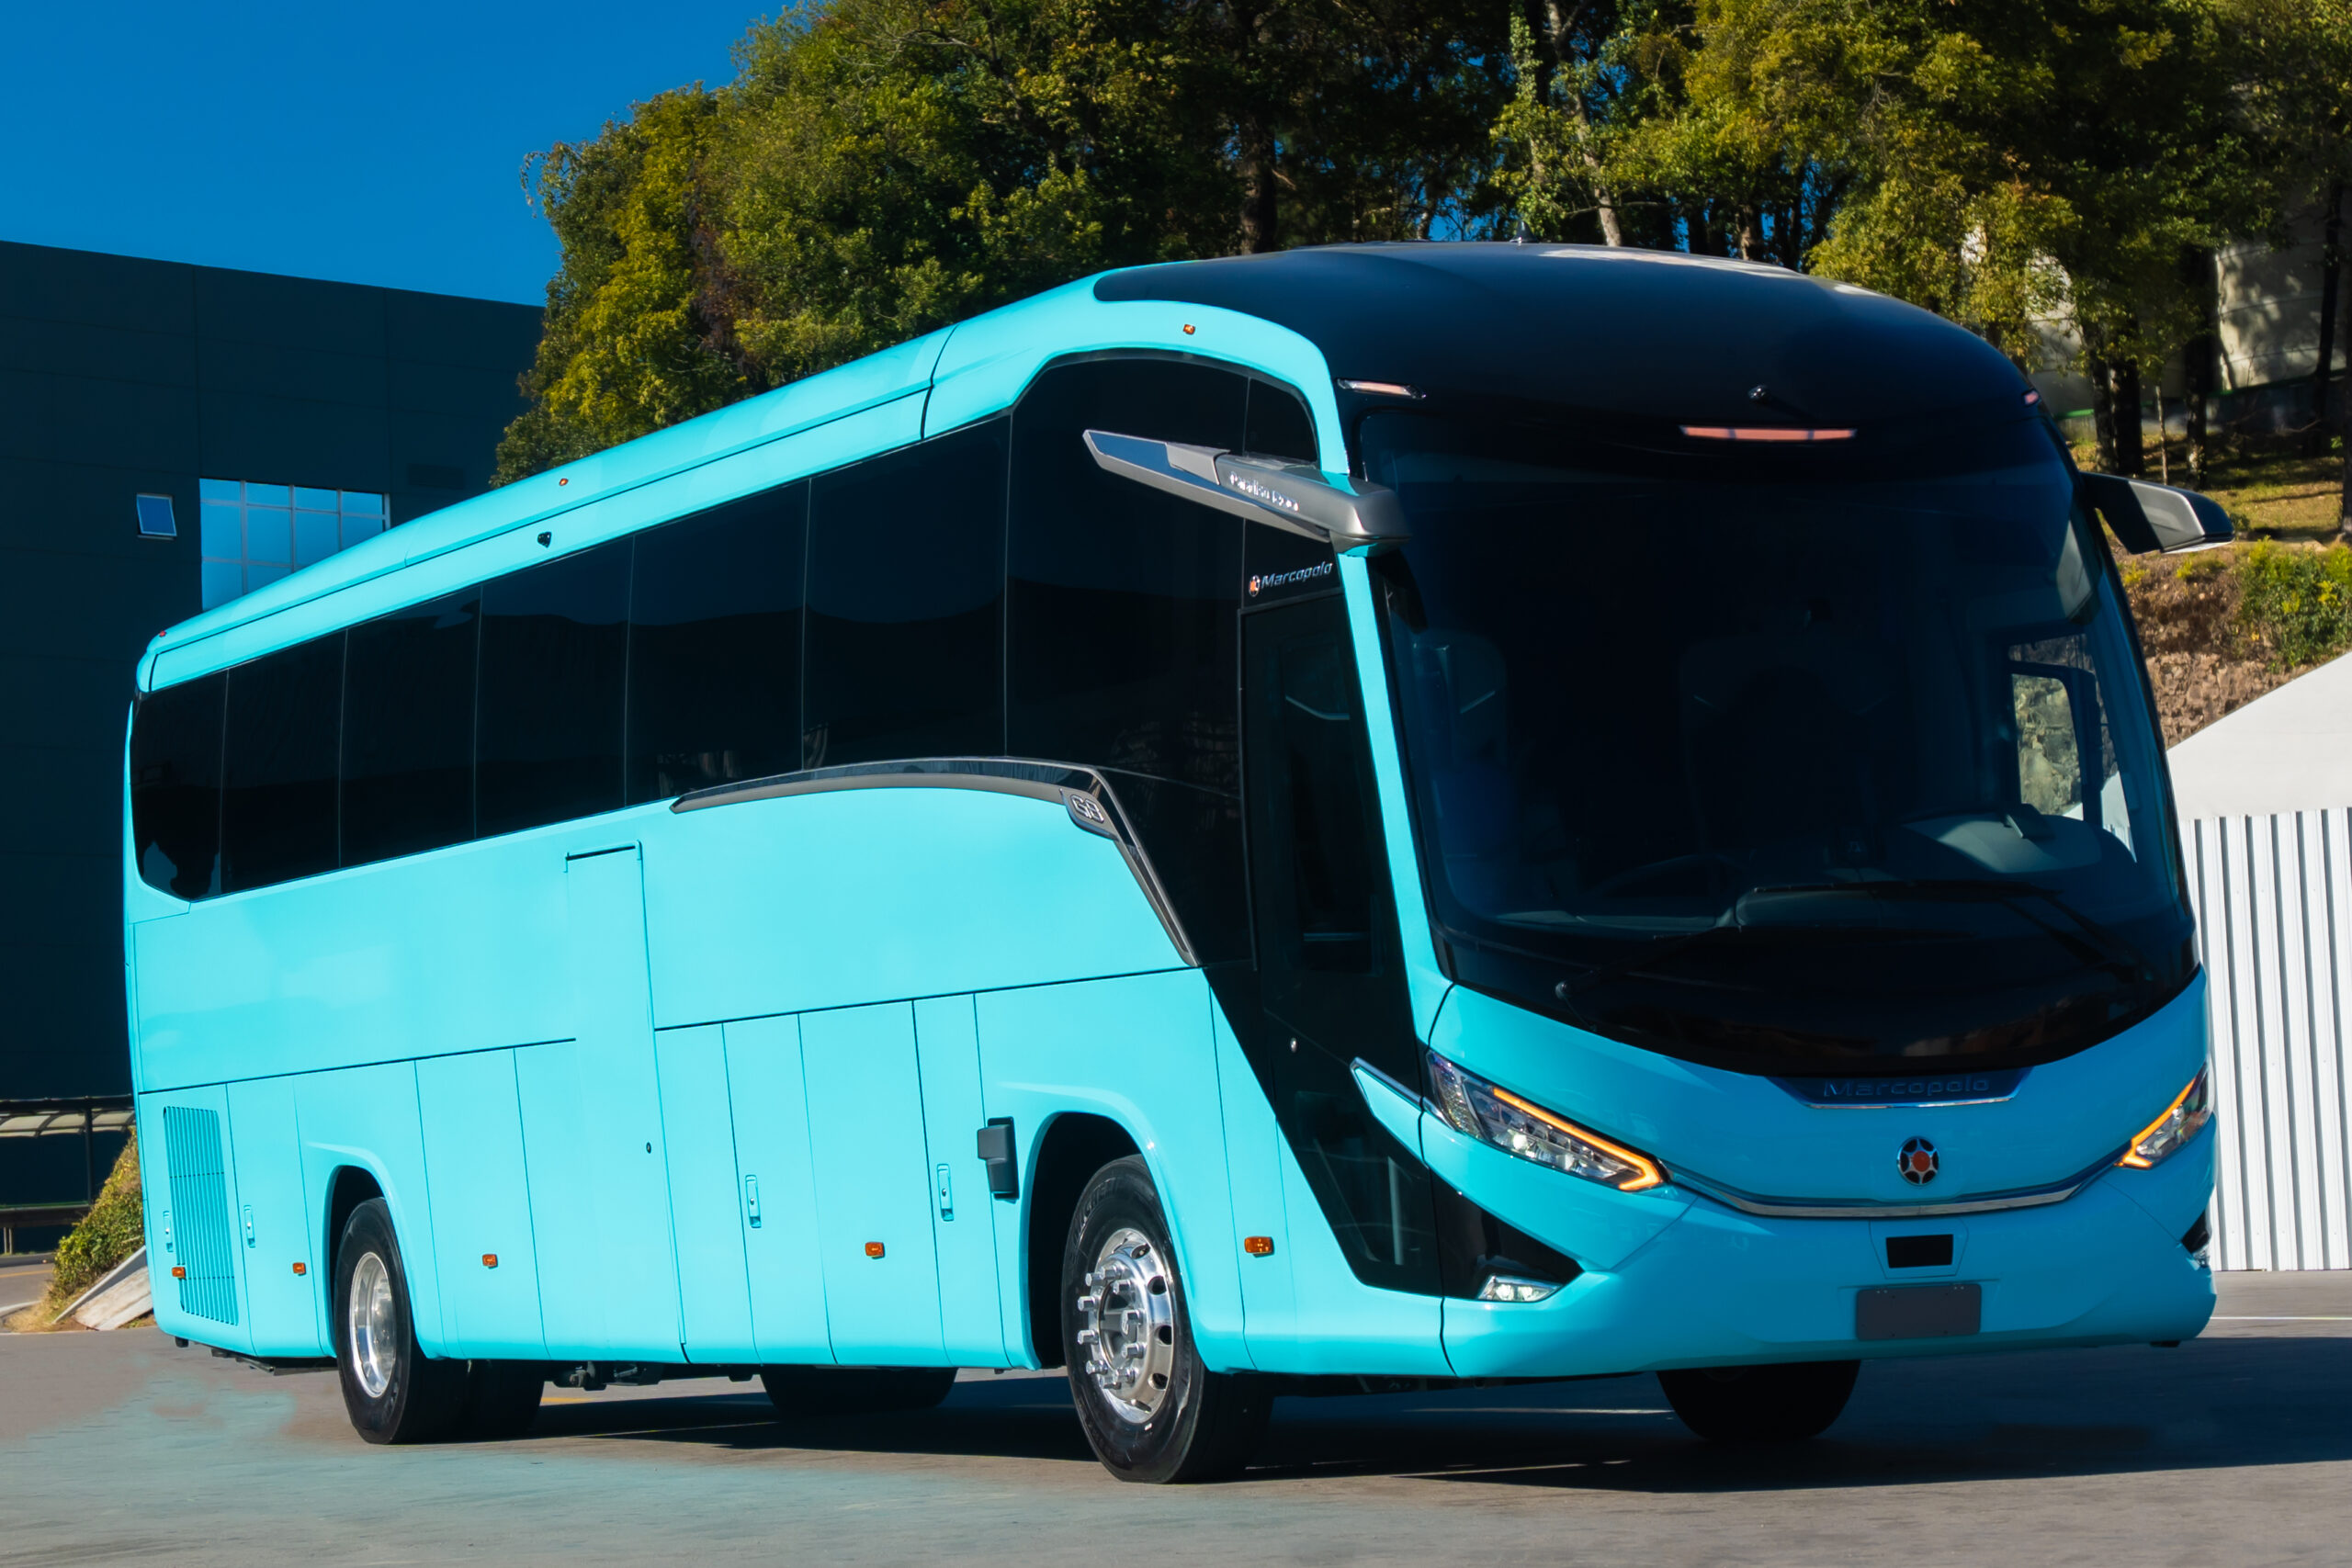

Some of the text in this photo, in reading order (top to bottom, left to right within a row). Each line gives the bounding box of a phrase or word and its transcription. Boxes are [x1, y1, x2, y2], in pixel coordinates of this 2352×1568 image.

[1261, 561, 1333, 589] Marcopolo
[1071, 795, 1104, 823] G8
[1823, 1076, 1992, 1097] Marcopolo
